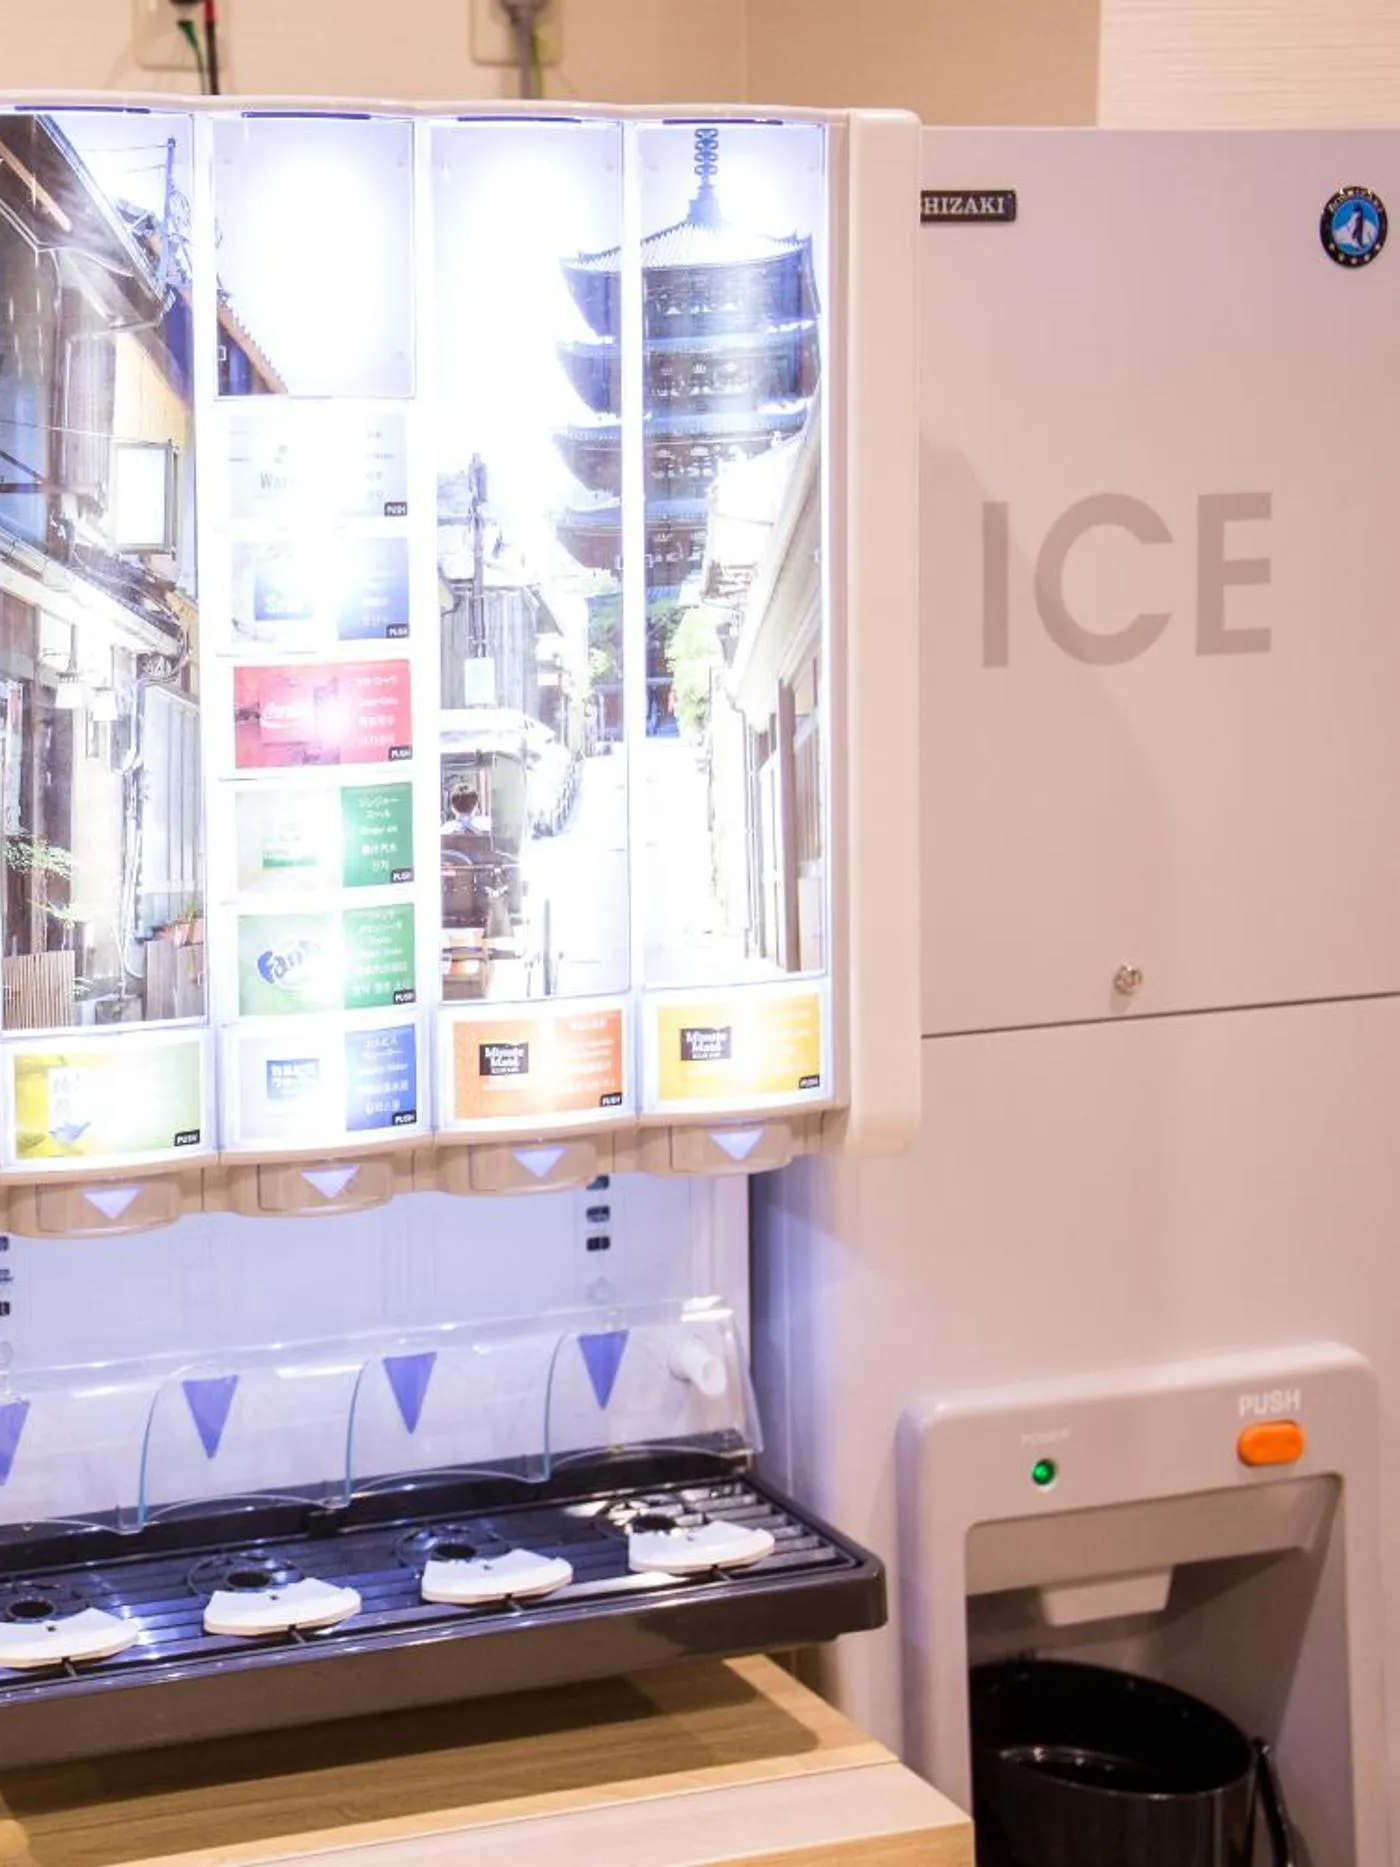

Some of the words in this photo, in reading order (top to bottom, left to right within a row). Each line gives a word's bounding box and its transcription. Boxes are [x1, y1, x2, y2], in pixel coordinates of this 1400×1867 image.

[923, 196, 1005, 216] HIZAKI
[981, 492, 1273, 668] ICE
[1238, 1388, 1301, 1417] PUSH
